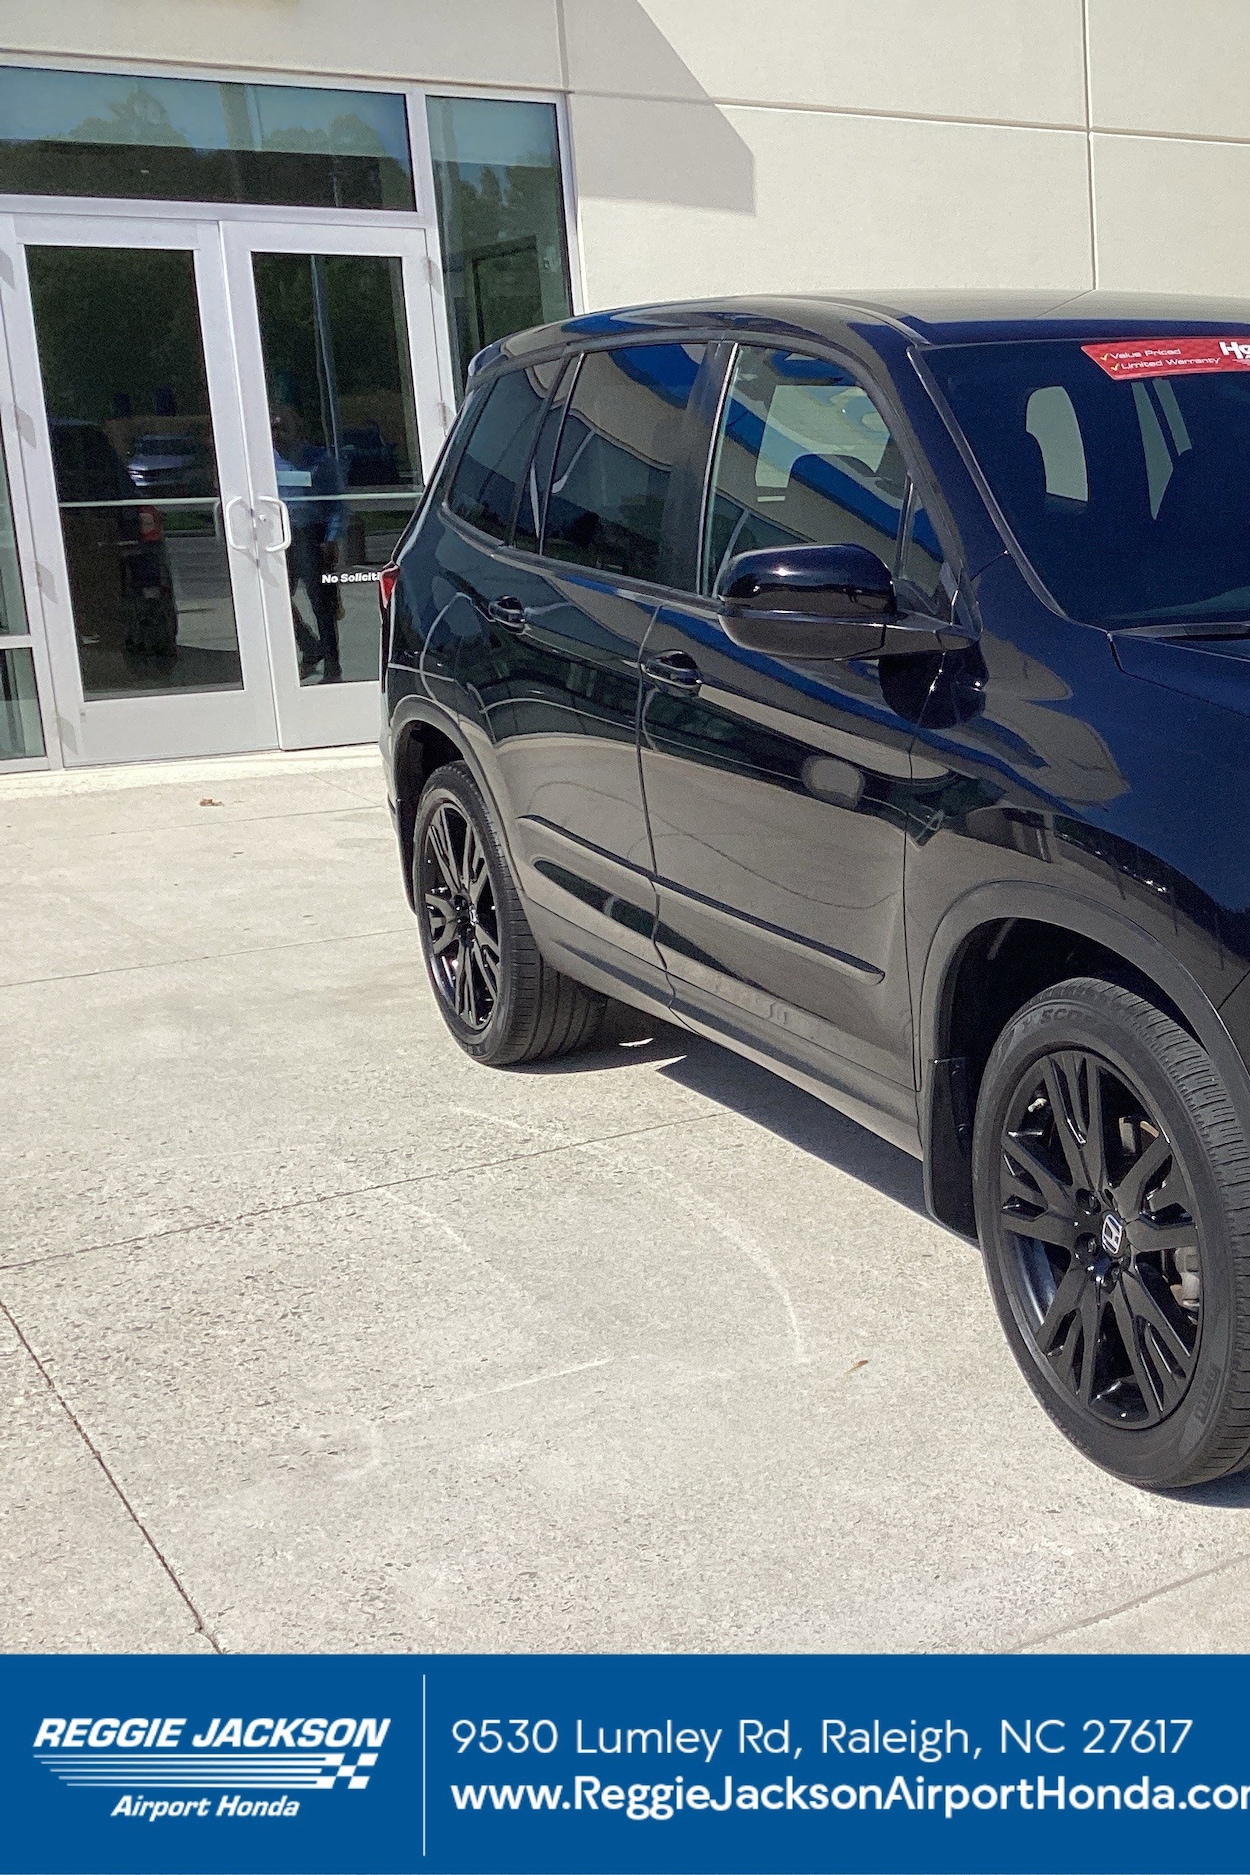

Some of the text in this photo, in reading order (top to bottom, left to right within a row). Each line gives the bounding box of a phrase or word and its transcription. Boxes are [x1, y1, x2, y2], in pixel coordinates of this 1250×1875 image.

[1110, 348, 1181, 359] Value Priced
[1121, 357, 1220, 370] Limited Warranty
[321, 574, 339, 584] No
